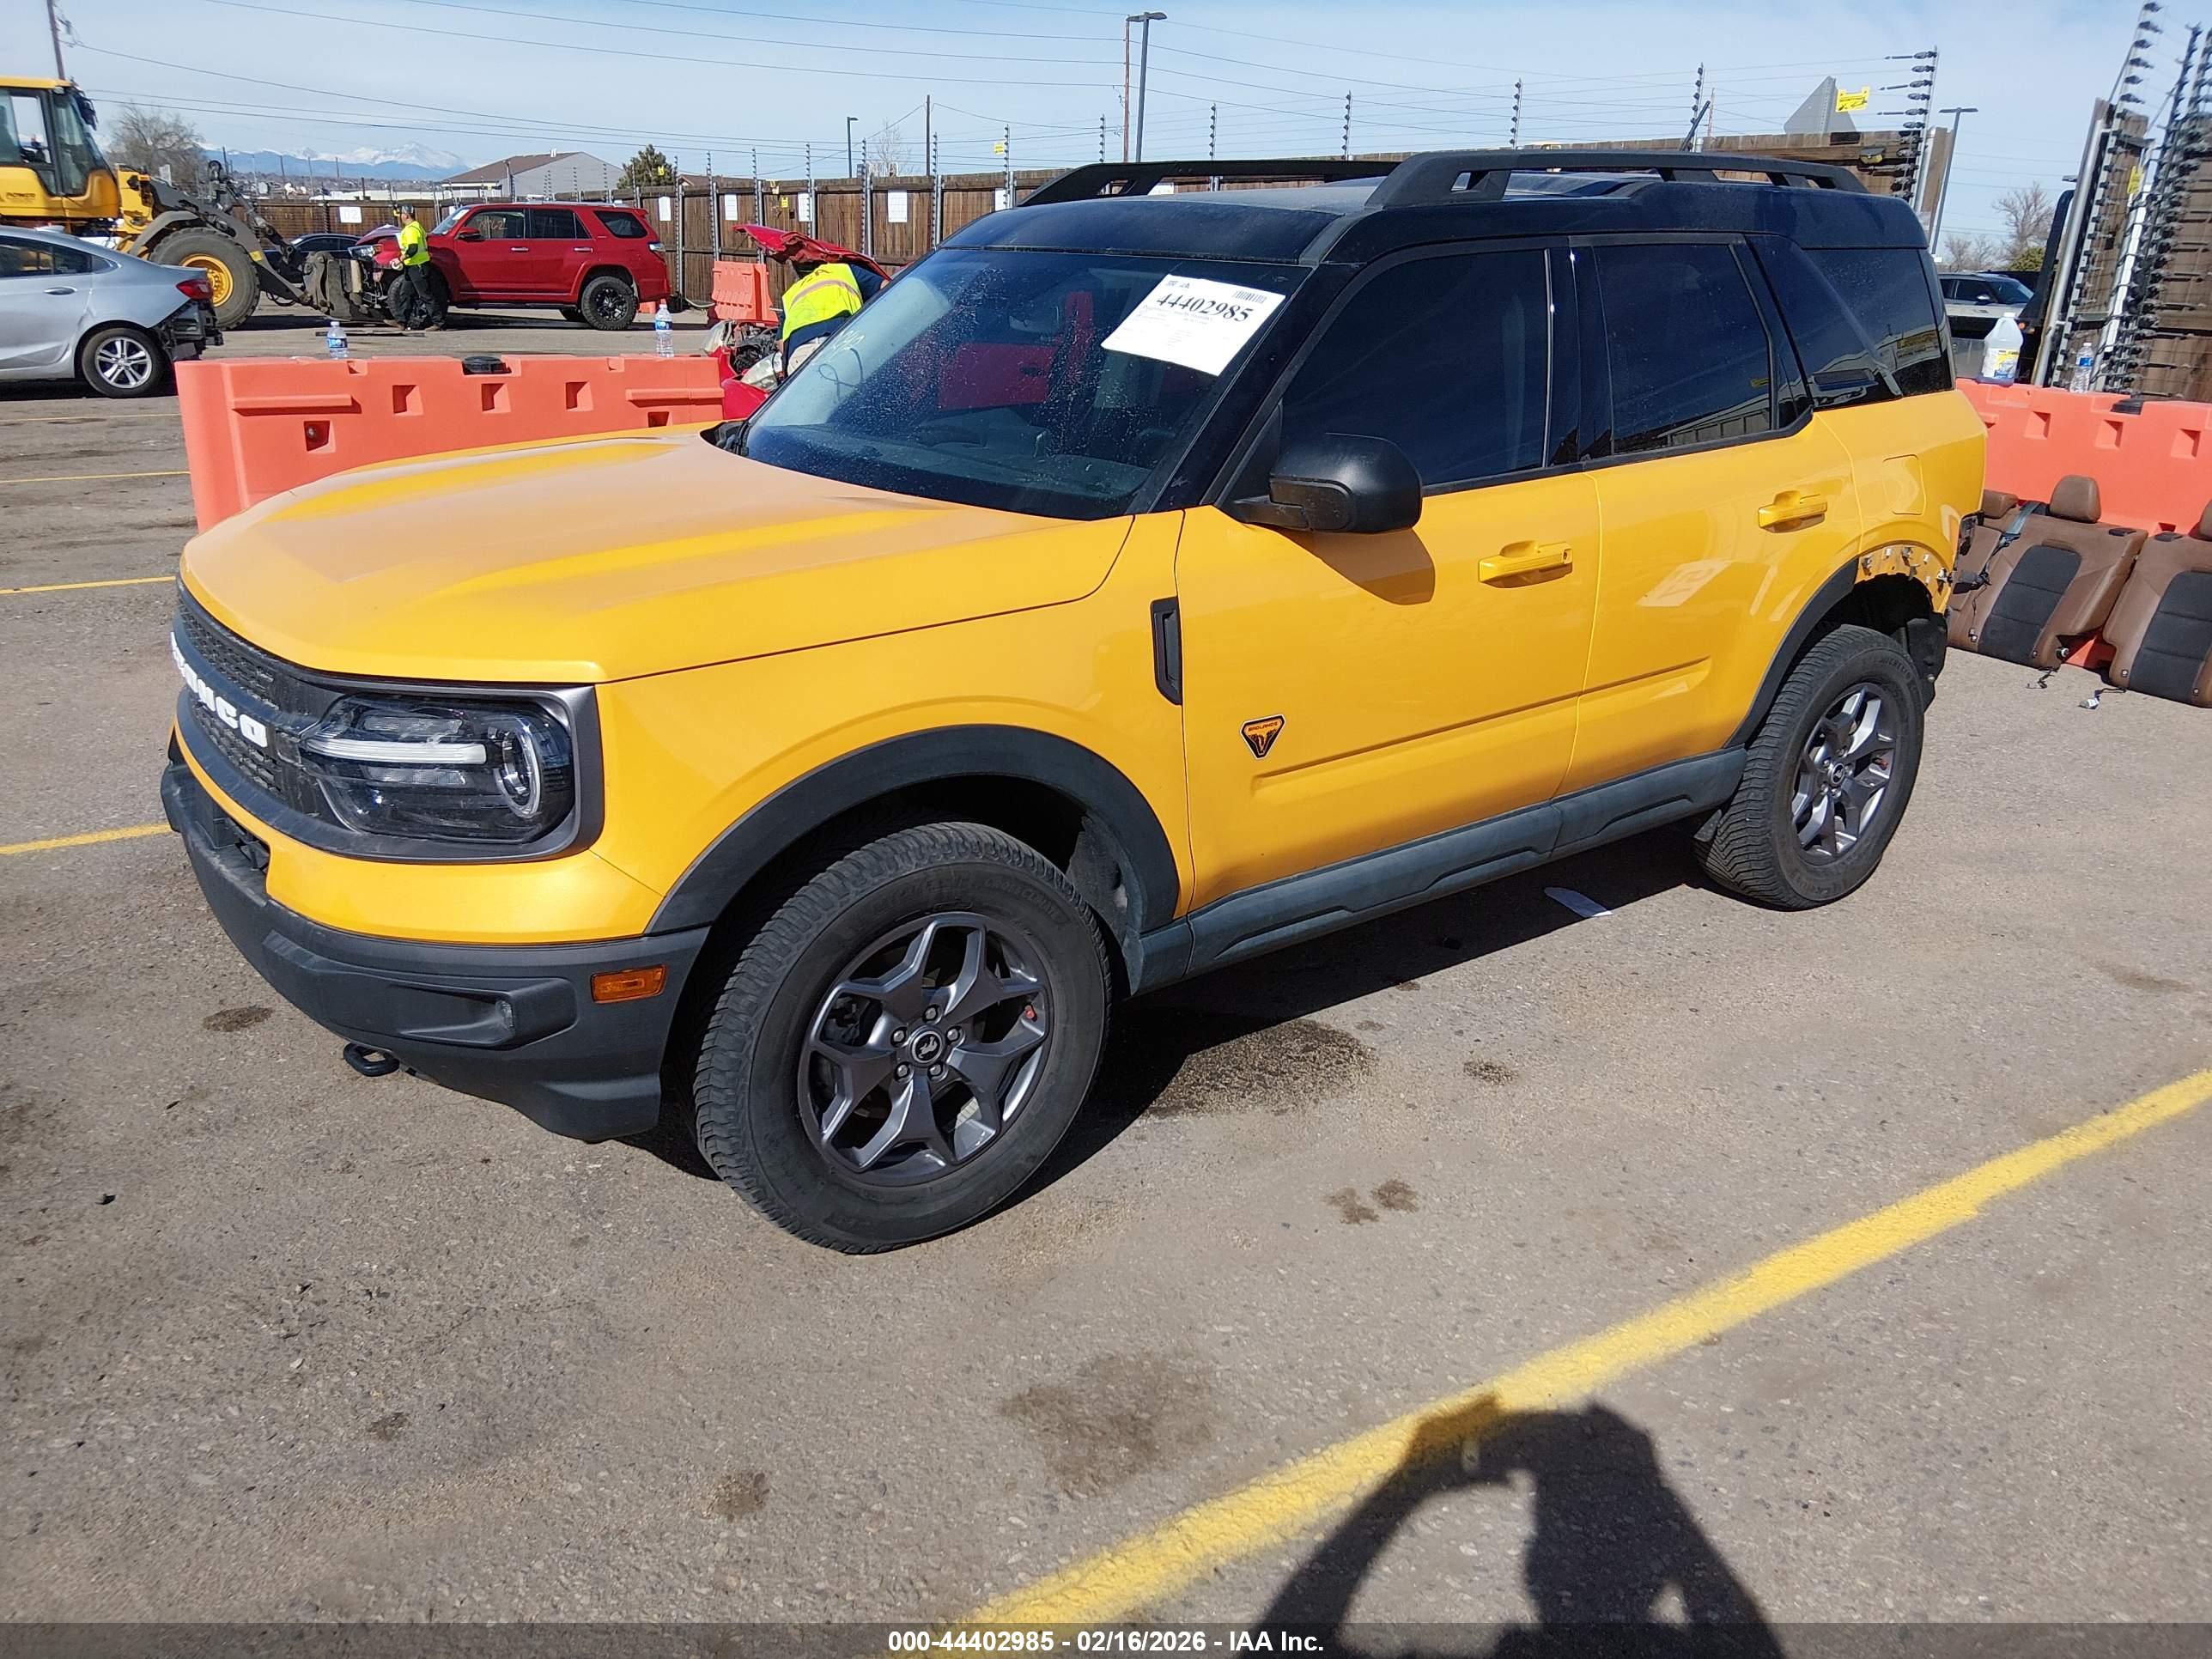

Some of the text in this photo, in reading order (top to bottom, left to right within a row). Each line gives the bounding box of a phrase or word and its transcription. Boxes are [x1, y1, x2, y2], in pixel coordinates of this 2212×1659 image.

[1157, 293, 1255, 322] 44402985
[171, 631, 268, 748] ONCO
[1248, 721, 1279, 732] BADLANDS
